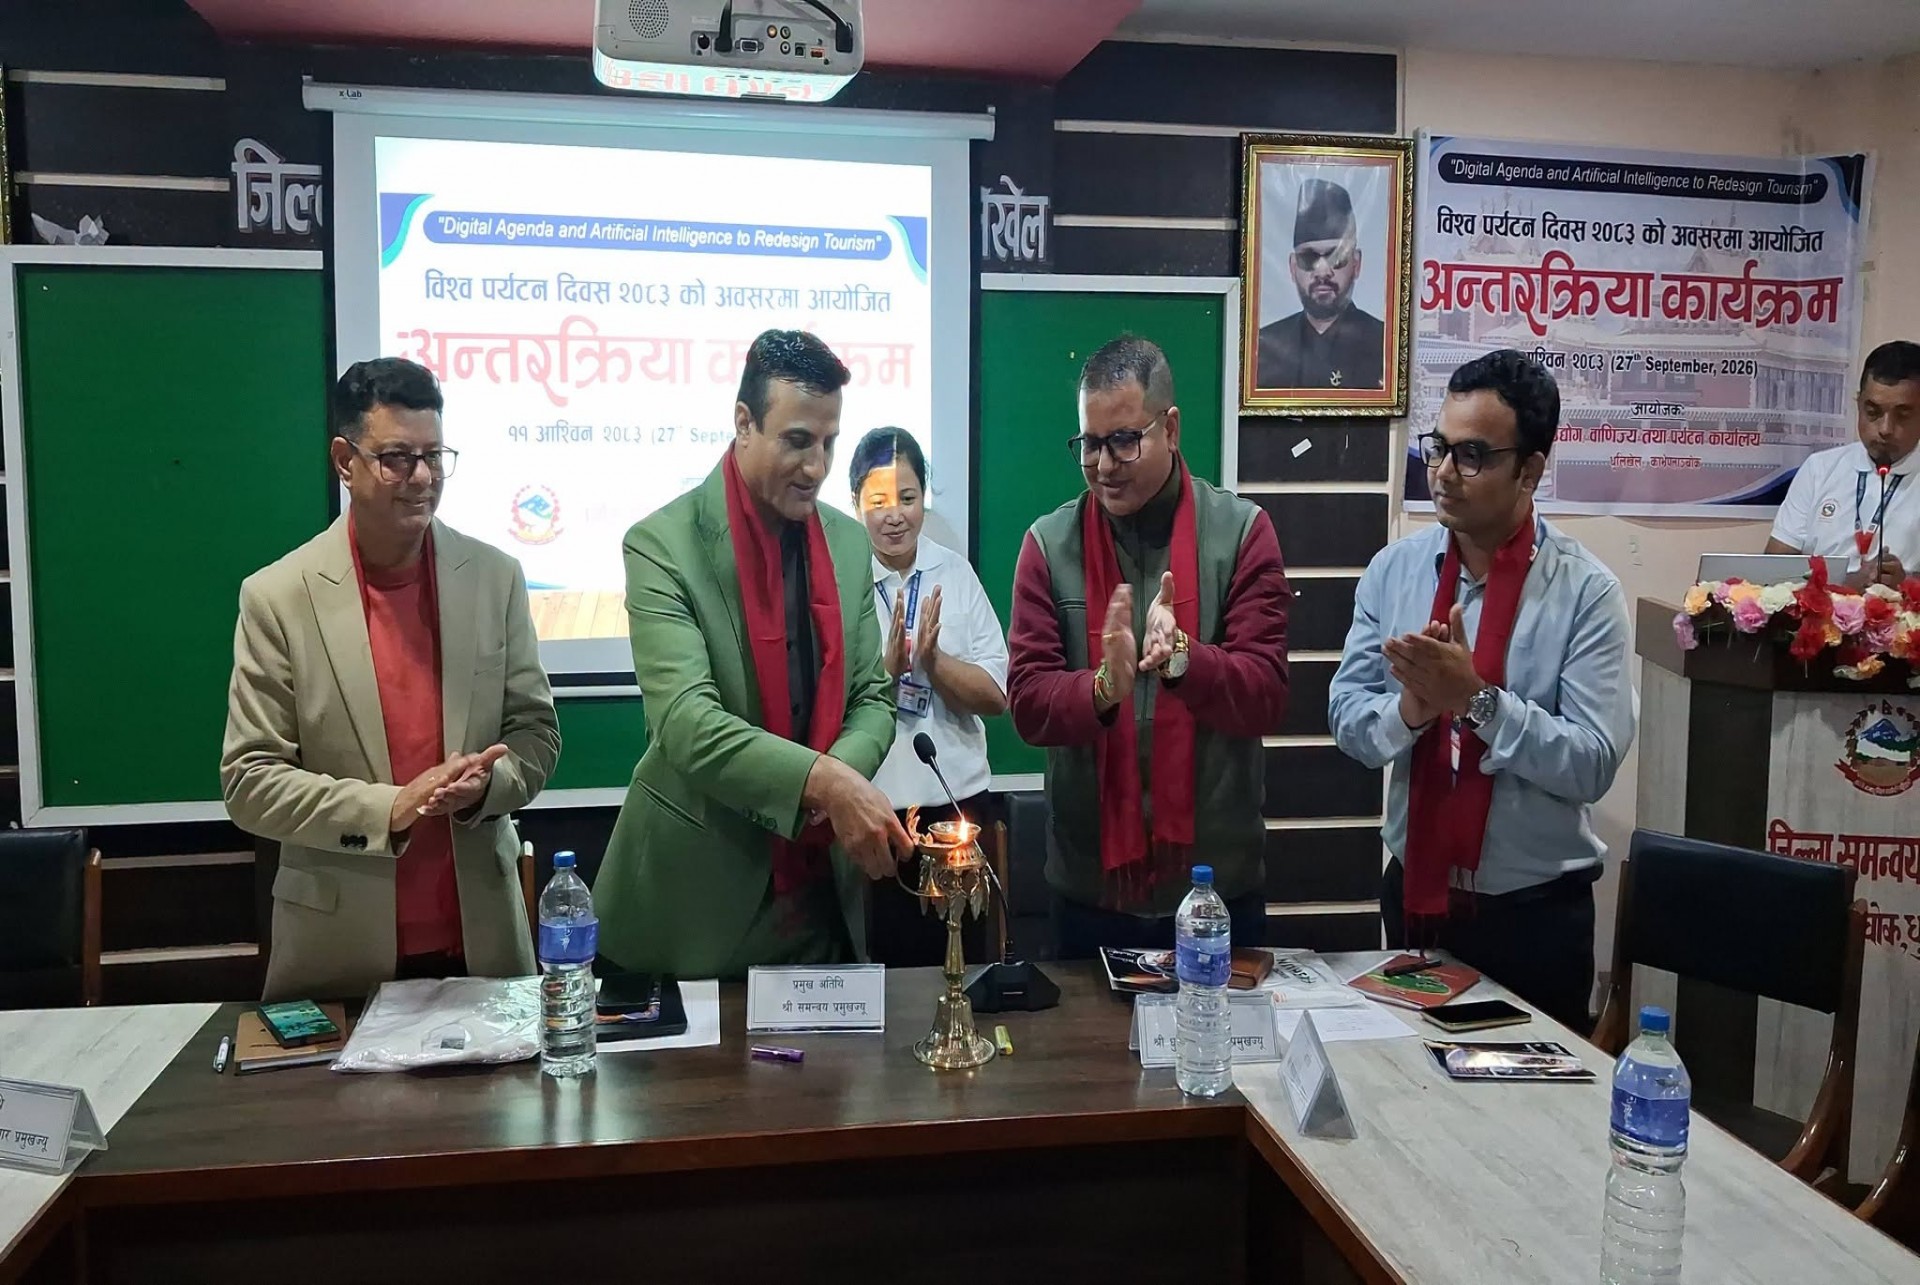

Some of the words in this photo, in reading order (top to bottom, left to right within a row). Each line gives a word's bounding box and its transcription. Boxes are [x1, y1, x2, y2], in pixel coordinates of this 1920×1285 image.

[1451, 159, 1493, 179] "Digital
[1496, 162, 1543, 181] Agenda
[1547, 165, 1569, 181] and
[1572, 167, 1621, 184] Artificial
[1623, 169, 1689, 190] Intelligence
[1692, 175, 1704, 188] to
[1707, 175, 1763, 196] Redesign
[438, 215, 492, 239] "Digital
[495, 219, 554, 240] Agenda
[558, 221, 586, 239] and
[590, 223, 649, 242] Artificial
[652, 225, 732, 247] Intelligence
[736, 230, 750, 246] to
[754, 230, 819, 252] Redesign
[1437, 205, 1476, 237] विश्व
[1483, 211, 1536, 239] पर्यटन
[1542, 211, 1587, 243] दिवस
[1592, 222, 1635, 245] २०८३
[1642, 217, 1667, 245] को
[1672, 225, 1743, 250] अवसरमा
[1749, 225, 1825, 253] आयोजित
[425, 268, 473, 300] विश्व
[482, 272, 548, 301] पर्यटन
[557, 272, 611, 304] दिवस
[619, 283, 670, 306] २०८३
[680, 278, 705, 307] को
[715, 285, 800, 310] अवसरमा
[808, 283, 891, 312] आयोजित
[1420, 250, 1655, 337] अन्तरक्रिया
[1661, 259, 1843, 328] कार्यक्रम
[1573, 353, 1603, 371] २०८३
[1611, 353, 1641, 373] (27th
[1645, 356, 1717, 377] September,
[1721, 360, 1758, 379] 2026)
[508, 425, 528, 442] ११
[536, 419, 593, 444] आश्विन
[603, 426, 642, 444] २०८३
[1590, 423, 1637, 443] वाणिज्य
[1642, 428, 1666, 444] तथा
[1671, 427, 1704, 445] पर्यटन
[1709, 428, 1761, 447] कार्यालय
[793, 980, 814, 994] प्रमुख
[820, 976, 845, 989] अतिथि
[782, 1000, 793, 1012] श्री
[797, 1002, 829, 1012] समन्वय
[1154, 1034, 1164, 1048] श्री
